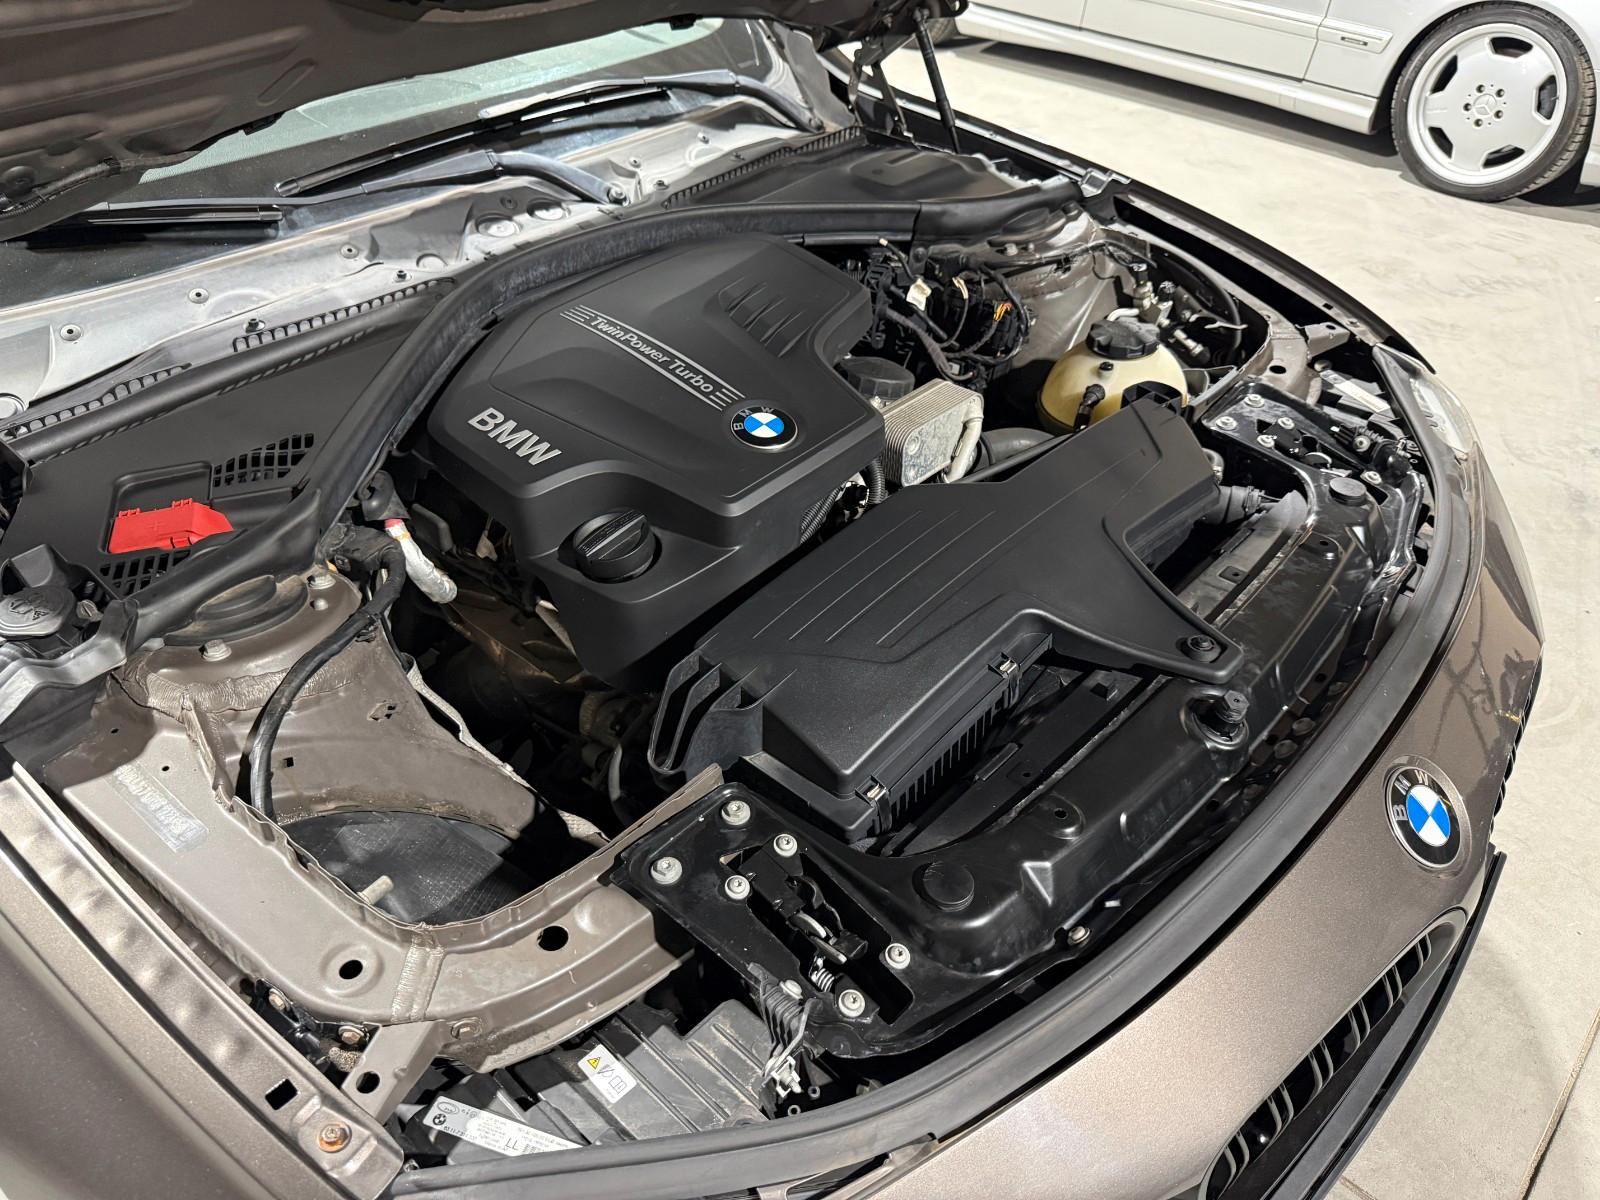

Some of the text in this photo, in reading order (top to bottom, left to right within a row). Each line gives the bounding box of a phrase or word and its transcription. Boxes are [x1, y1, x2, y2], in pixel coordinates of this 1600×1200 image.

[590, 316, 714, 393] TwinPower Turbo
[467, 407, 563, 466] BMW
[733, 406, 775, 431] BMW
[1392, 769, 1429, 821] BMW
